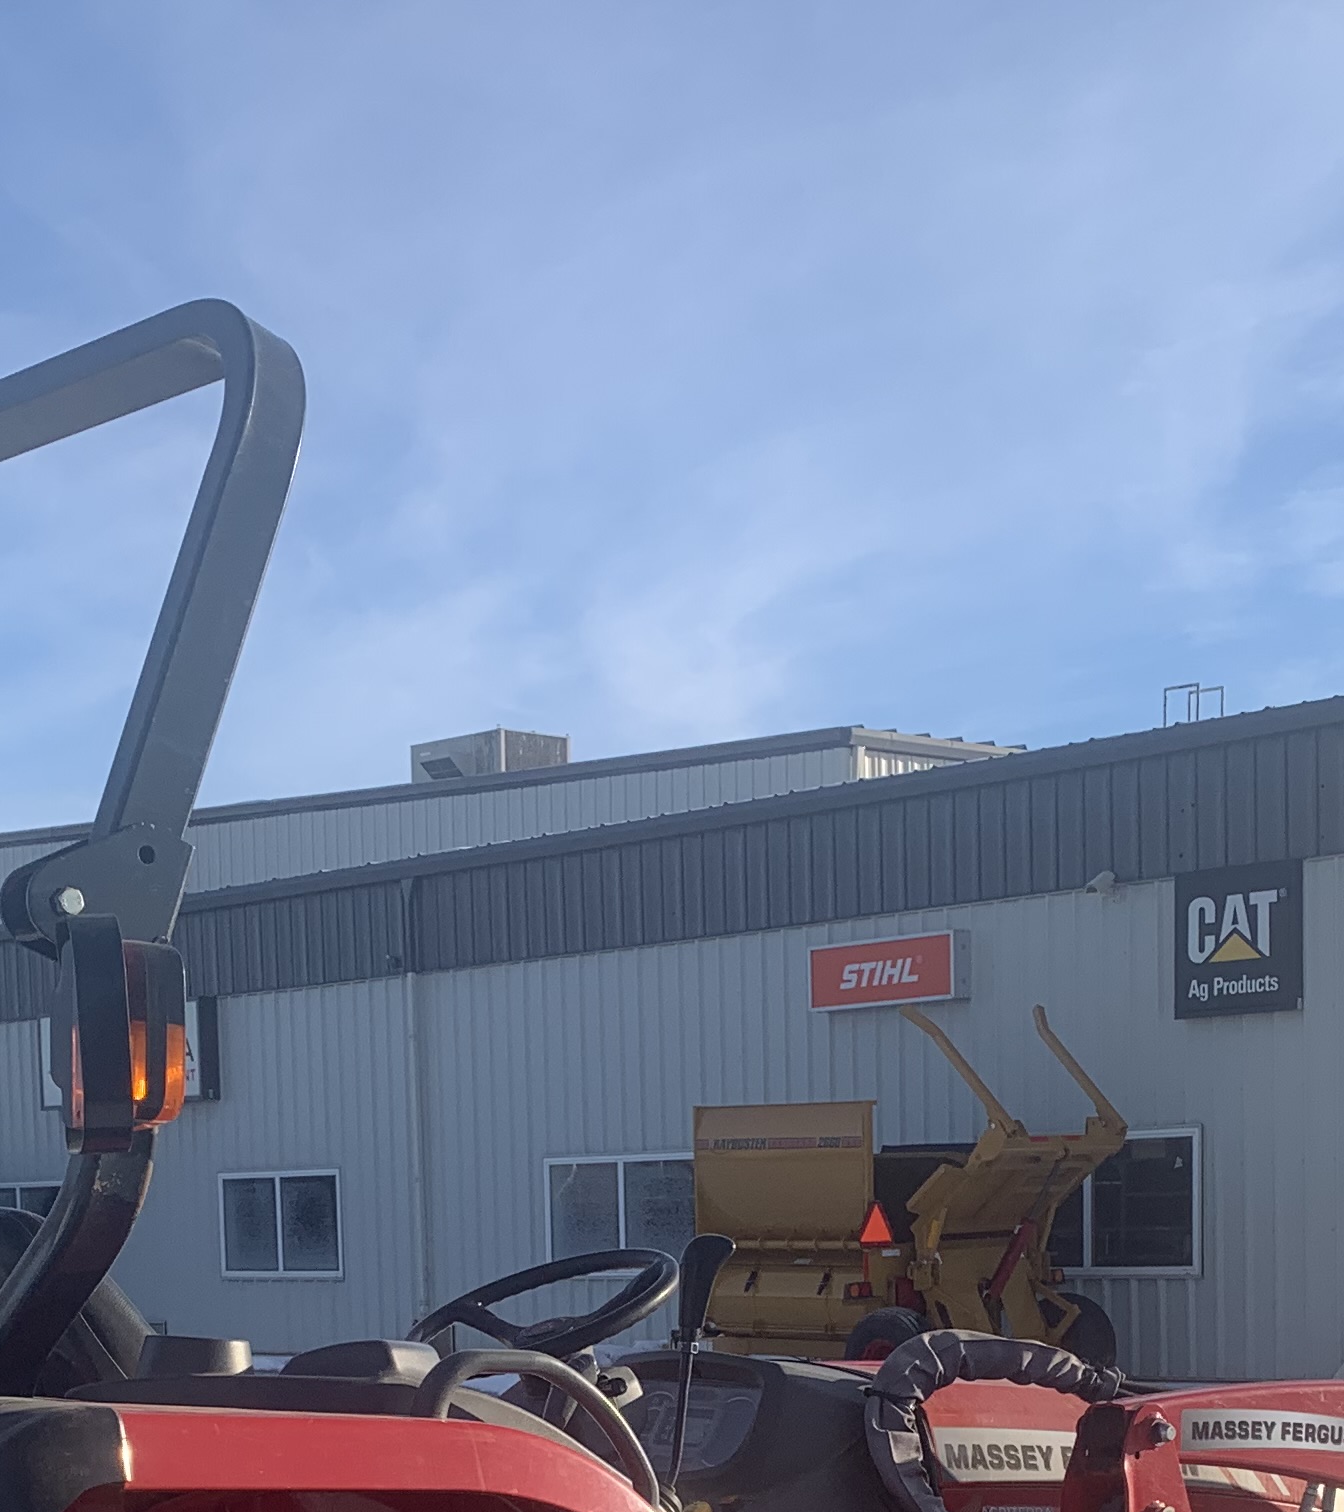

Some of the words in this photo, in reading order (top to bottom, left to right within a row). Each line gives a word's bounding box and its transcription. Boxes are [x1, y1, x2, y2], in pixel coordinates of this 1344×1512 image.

[1188, 889, 1277, 964] CAT
[840, 957, 919, 990] STIHL
[1188, 980, 1209, 1001] Ag
[1213, 974, 1278, 996] Products
[1191, 1421, 1276, 1441] MASSEY
[944, 1443, 1054, 1471] MASSEY
